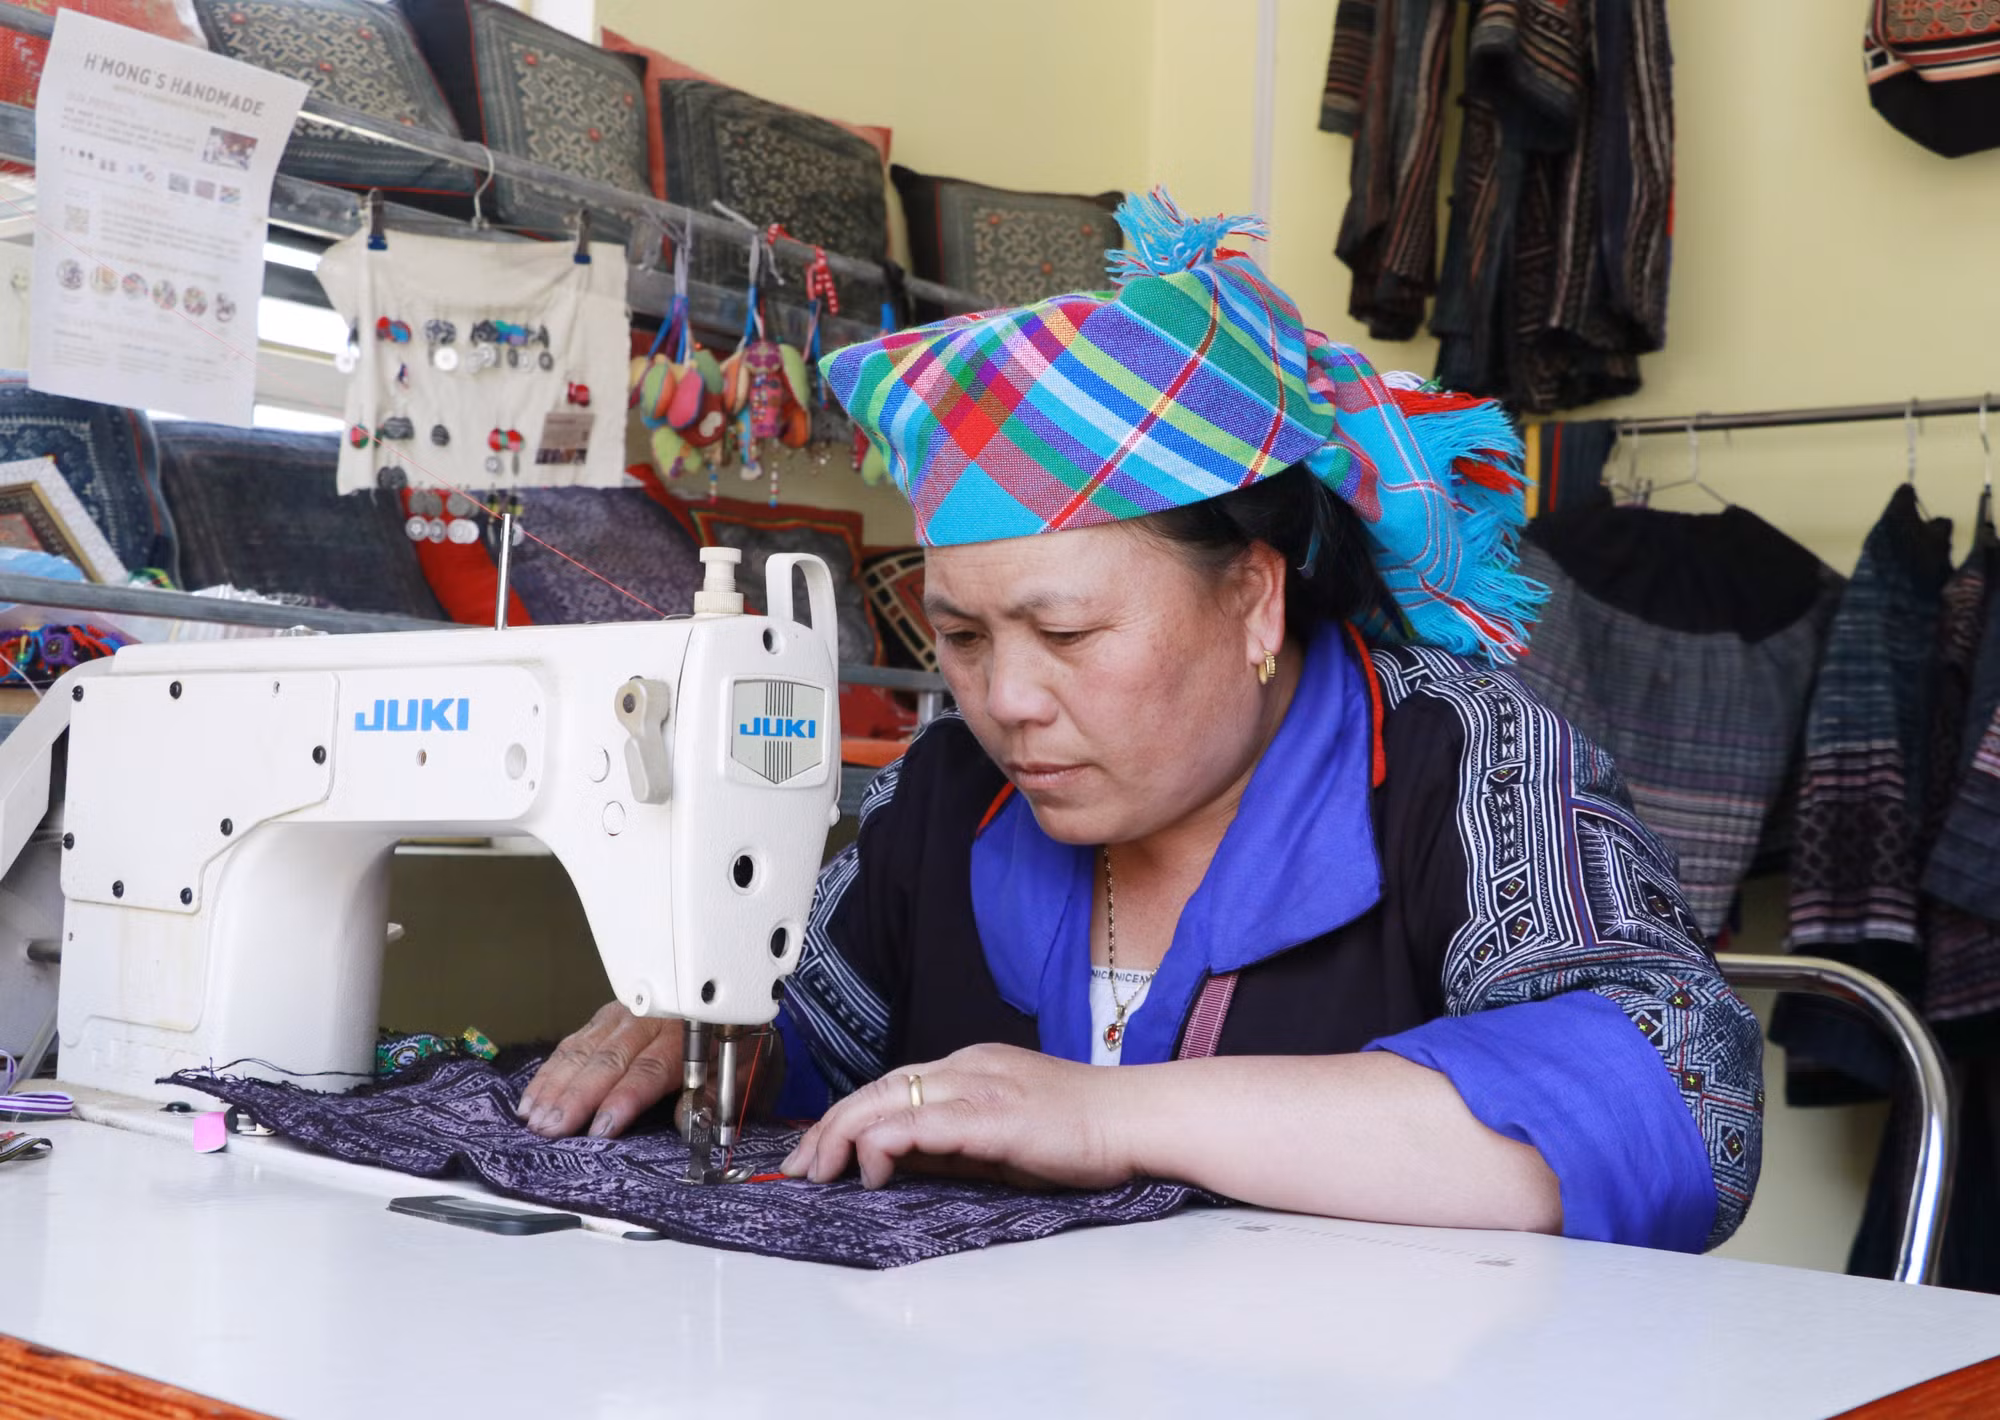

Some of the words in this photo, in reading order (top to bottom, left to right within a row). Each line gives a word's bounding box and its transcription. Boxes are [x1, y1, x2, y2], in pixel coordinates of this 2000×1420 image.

[169, 77, 265, 116] HANDMADE
[356, 698, 469, 732] JUKI
[740, 718, 816, 738] JUKI
